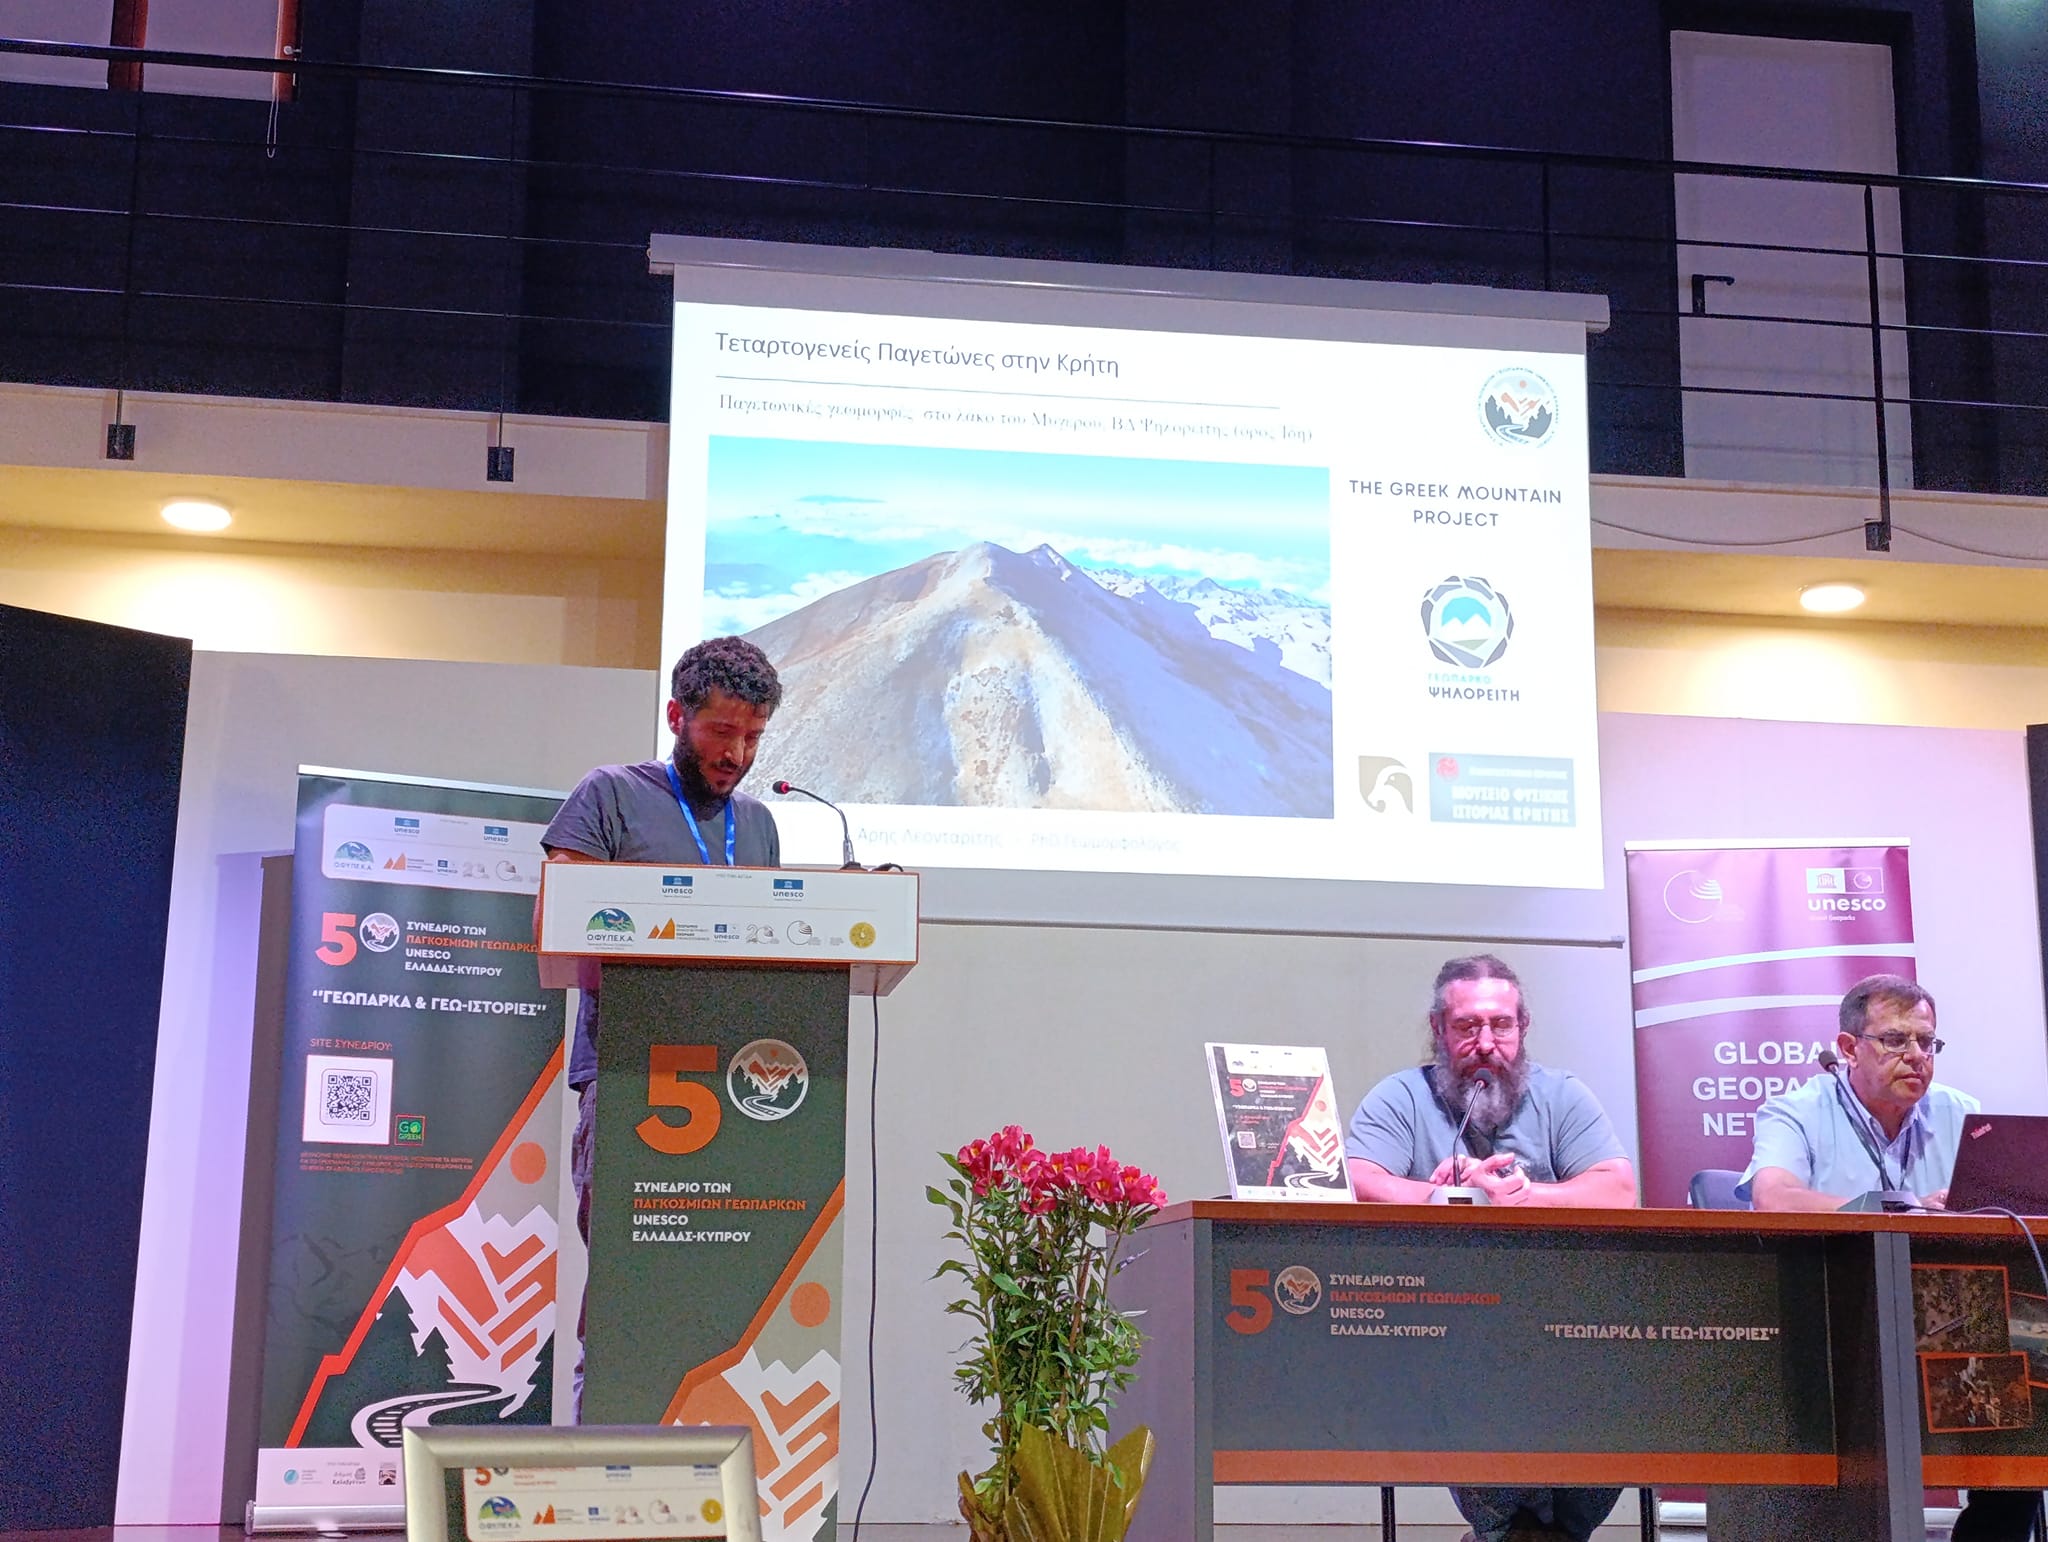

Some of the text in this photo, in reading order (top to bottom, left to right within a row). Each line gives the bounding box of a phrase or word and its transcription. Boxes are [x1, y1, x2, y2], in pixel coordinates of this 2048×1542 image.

[715, 332, 1119, 379] Τεταρτογενείς Παγετώνες στην Κρήτη
[1349, 480, 1562, 503] THE GREEK MOUNTAIN
[1413, 510, 1499, 526] PROJECT
[1428, 686, 1520, 701] ΨΗΛΟΡΕΙΤΗ
[1452, 804, 1511, 821] ΙΣΤΟΡΙΑΣ
[661, 887, 694, 895] unesco
[772, 890, 804, 898] unesco
[1807, 897, 1887, 912] unesco
[406, 921, 487, 936] ΣΥΝΕΔΡΙΟ ΤΩΝ
[406, 934, 478, 949] ΠΑΓΚΟΣΜΙΩΝ
[587, 933, 634, 943] ΟΦΥΠΕΚΑ
[405, 948, 451, 960] UNESCO
[404, 961, 503, 977] ΕΛΛΑΔΑΣ-ΚΥΠΡΟΥ
[415, 997, 427, 1010] &
[310, 1038, 333, 1048] SITE
[1713, 1041, 1848, 1065] GLOBAL
[398, 1132, 422, 1141] GREEN
[633, 1181, 731, 1194] ΣΥΝΕΔΡΙΟ ΤΩΝ
[633, 1198, 807, 1211] ΠΑΓΚΟΣΜΙΩΝ ΓΕΩΠΑΡΚΩΝ
[633, 1214, 689, 1226] UNESCO
[632, 1231, 751, 1243] ΕΛΛΑΔΑΣ-ΚΥΠΡΟΥ
[1329, 1273, 1425, 1287] ΣΥΝΕΔΡΙΟ ΤΩΝ
[1330, 1290, 1502, 1304] ΠΑΓΚΟΣΜΙΩΝ ΓΕΩΠΑΡΚΩΝ
[1330, 1307, 1385, 1320] UNESCO
[1330, 1324, 1447, 1337] ΕΛΛΑΔΑΣ-ΚΥΠΡΟΥ
[1645, 1326, 1658, 1340] &
